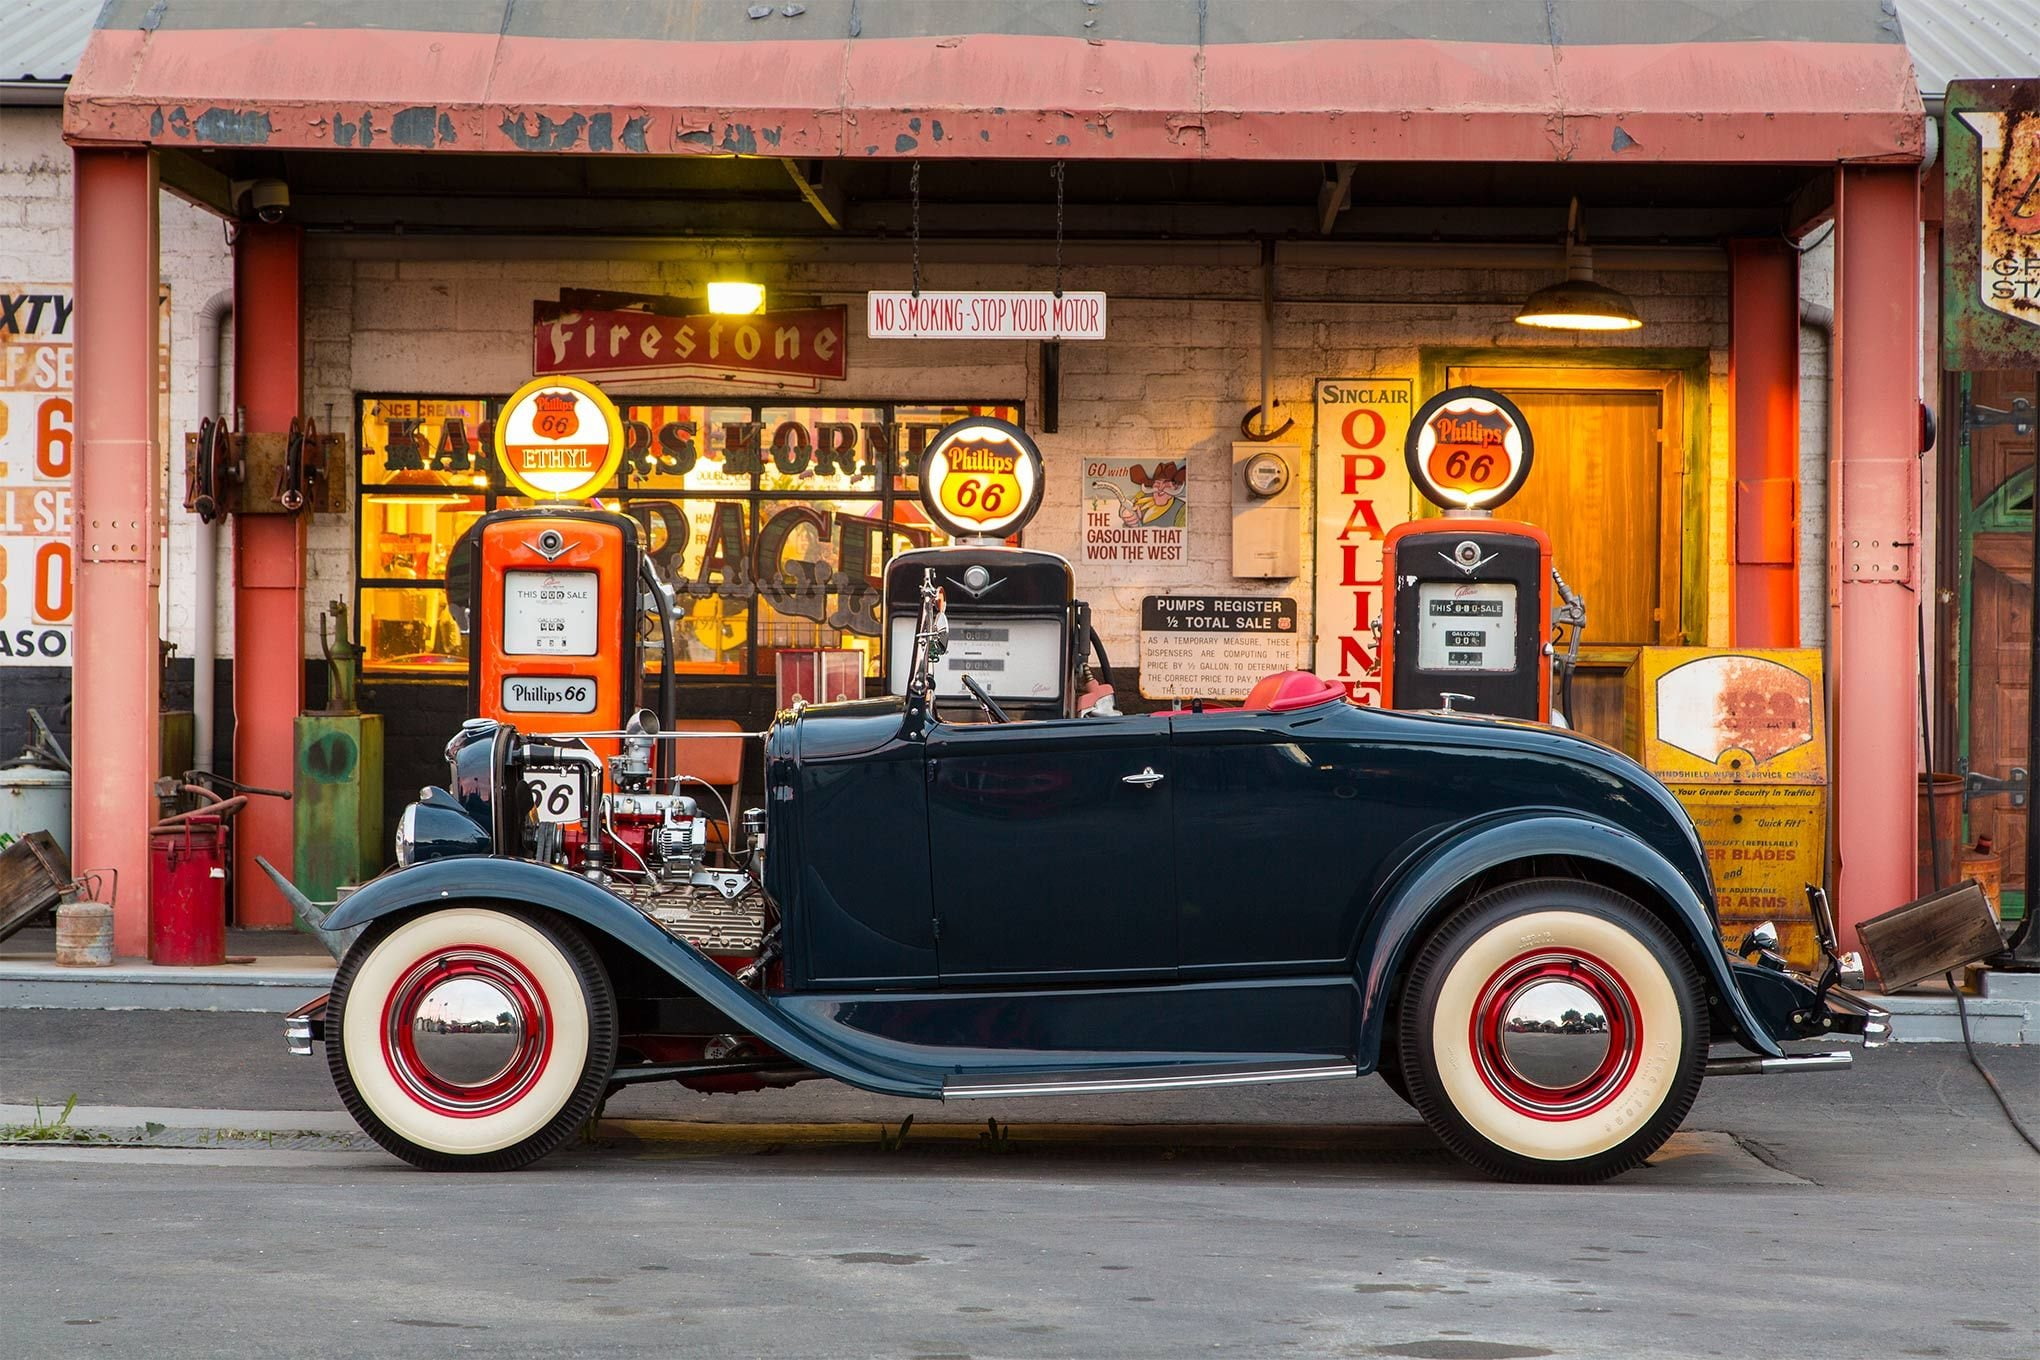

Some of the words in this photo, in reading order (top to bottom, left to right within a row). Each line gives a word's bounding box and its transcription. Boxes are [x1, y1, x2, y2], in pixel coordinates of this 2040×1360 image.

[876, 298, 894, 331] NO
[1010, 299, 1047, 331] YOUR
[1053, 299, 1098, 332] MOTOR
[544, 311, 838, 366] Firestone
[389, 404, 410, 415] ICE
[536, 396, 574, 412] Phillips
[542, 415, 569, 434] 66
[1437, 417, 1503, 449] Phillips
[522, 448, 593, 469] ETHYL
[948, 447, 1014, 474] Phillips
[1087, 463, 1107, 477] GO
[1107, 465, 1129, 477] with
[1446, 450, 1495, 483] 66
[956, 479, 1005, 512] 66
[1087, 513, 1110, 527] THE
[1087, 529, 1148, 544] GASOLINE
[1151, 529, 1182, 543] THAT
[1087, 546, 1118, 560] WON
[1121, 546, 1144, 560] THE
[1147, 546, 1182, 560] WEST
[518, 590, 537, 599] THIS
[567, 591, 588, 599] SALE
[1157, 600, 1205, 611] PUMPS
[1214, 600, 1282, 612] REGISTER
[1431, 604, 1452, 612] THIS
[1185, 616, 1229, 628] TOTAL
[1236, 617, 1271, 629] SALE
[0, 630, 72, 658] ASO
[1174, 637, 1218, 645] TEMPORARY
[1267, 638, 1290, 646] THESE
[1223, 650, 1267, 658] COMPUTING
[1147, 661, 1168, 669] PRICE
[1234, 663, 1244, 671] TO
[1247, 663, 1290, 671] DETERMINE
[1164, 674, 1198, 683] CORRECT
[1200, 675, 1222, 683] PRICE
[1225, 675, 1234, 683] TO
[512, 684, 563, 705] Phillips
[564, 686, 587, 702] 66
[1180, 687, 1204, 695] TOTAL
[1207, 687, 1227, 695] SALE
[1230, 688, 1250, 696] PRICE
[1734, 789, 1769, 798] Security
[1784, 789, 1815, 797] Traffic!
[1732, 849, 1796, 861] BLADES
[1723, 866, 1743, 879] and
[1738, 896, 1788, 908] ARMS
